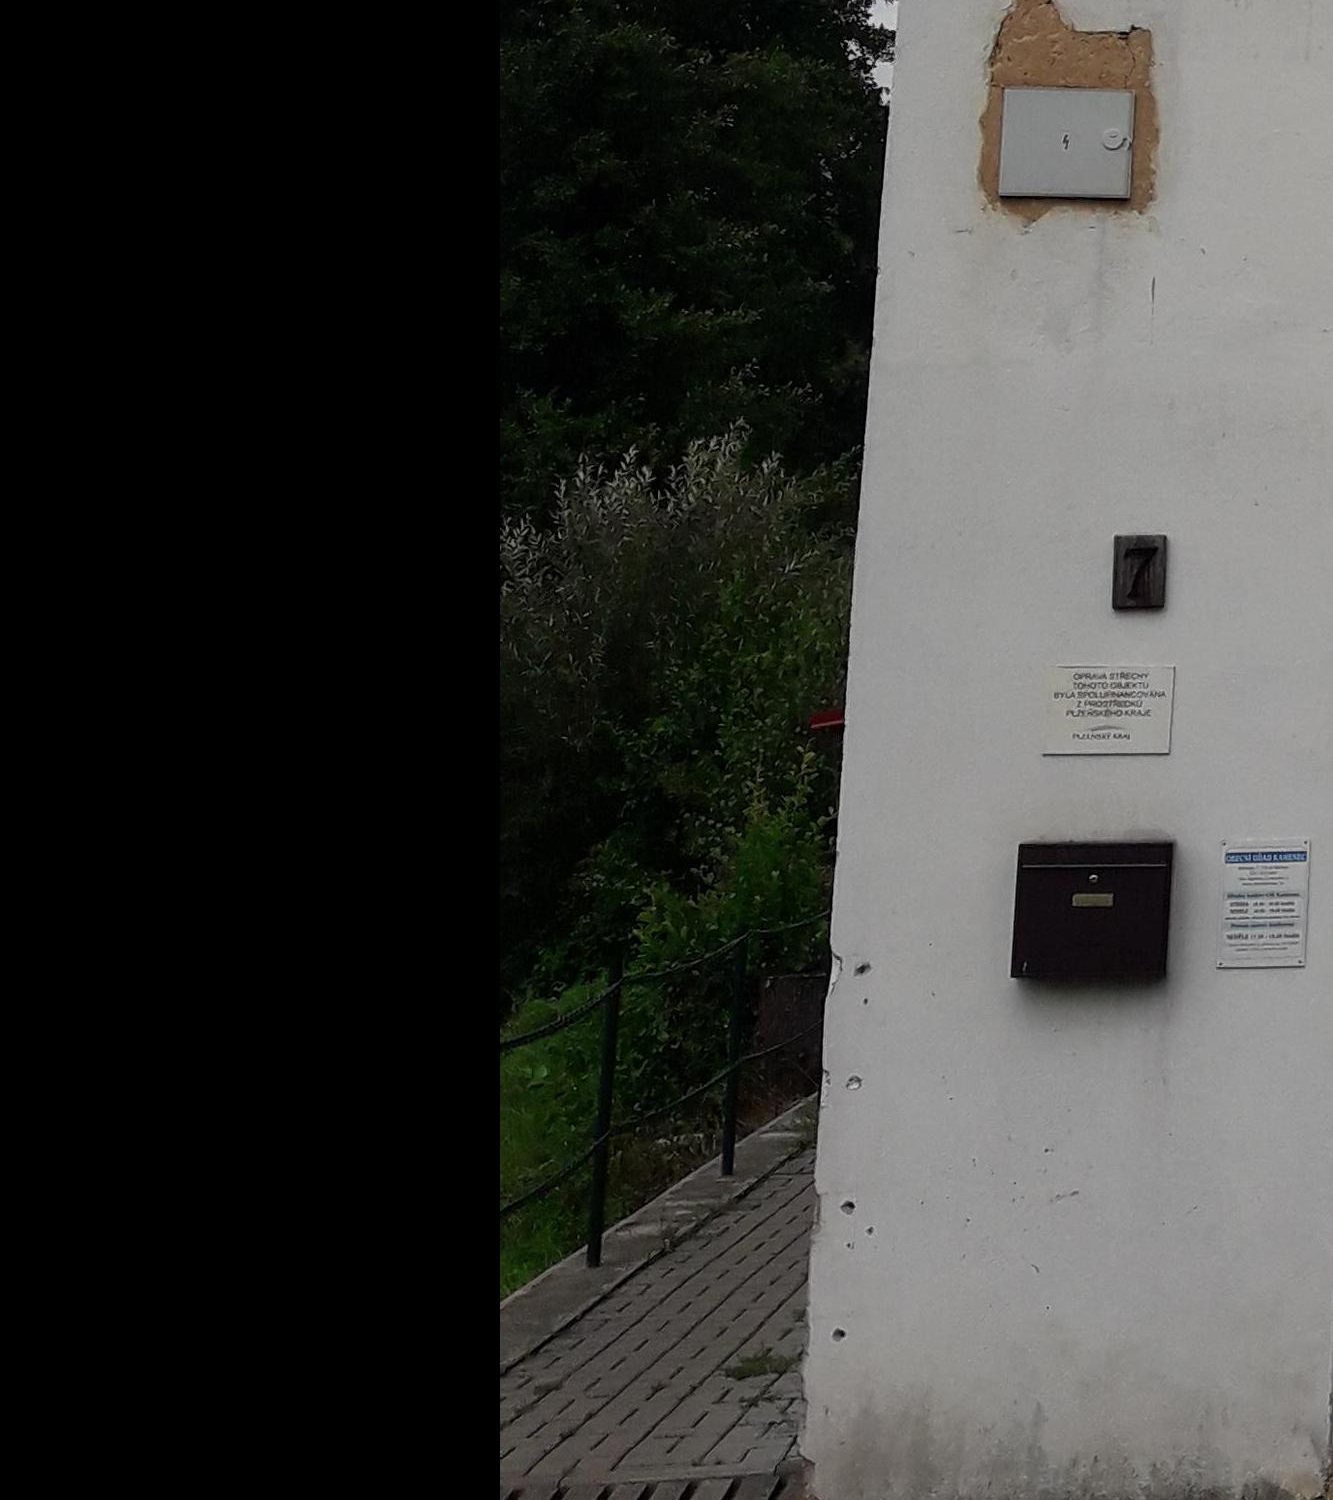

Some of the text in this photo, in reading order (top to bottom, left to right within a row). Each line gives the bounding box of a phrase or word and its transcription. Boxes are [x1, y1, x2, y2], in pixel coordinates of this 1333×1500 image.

[1124, 546, 1159, 599] 7
[1072, 672, 1107, 681] OPRAVA
[1073, 681, 1149, 690] TOHOTO OBJEKTU
[1053, 691, 1076, 700] BYLA
